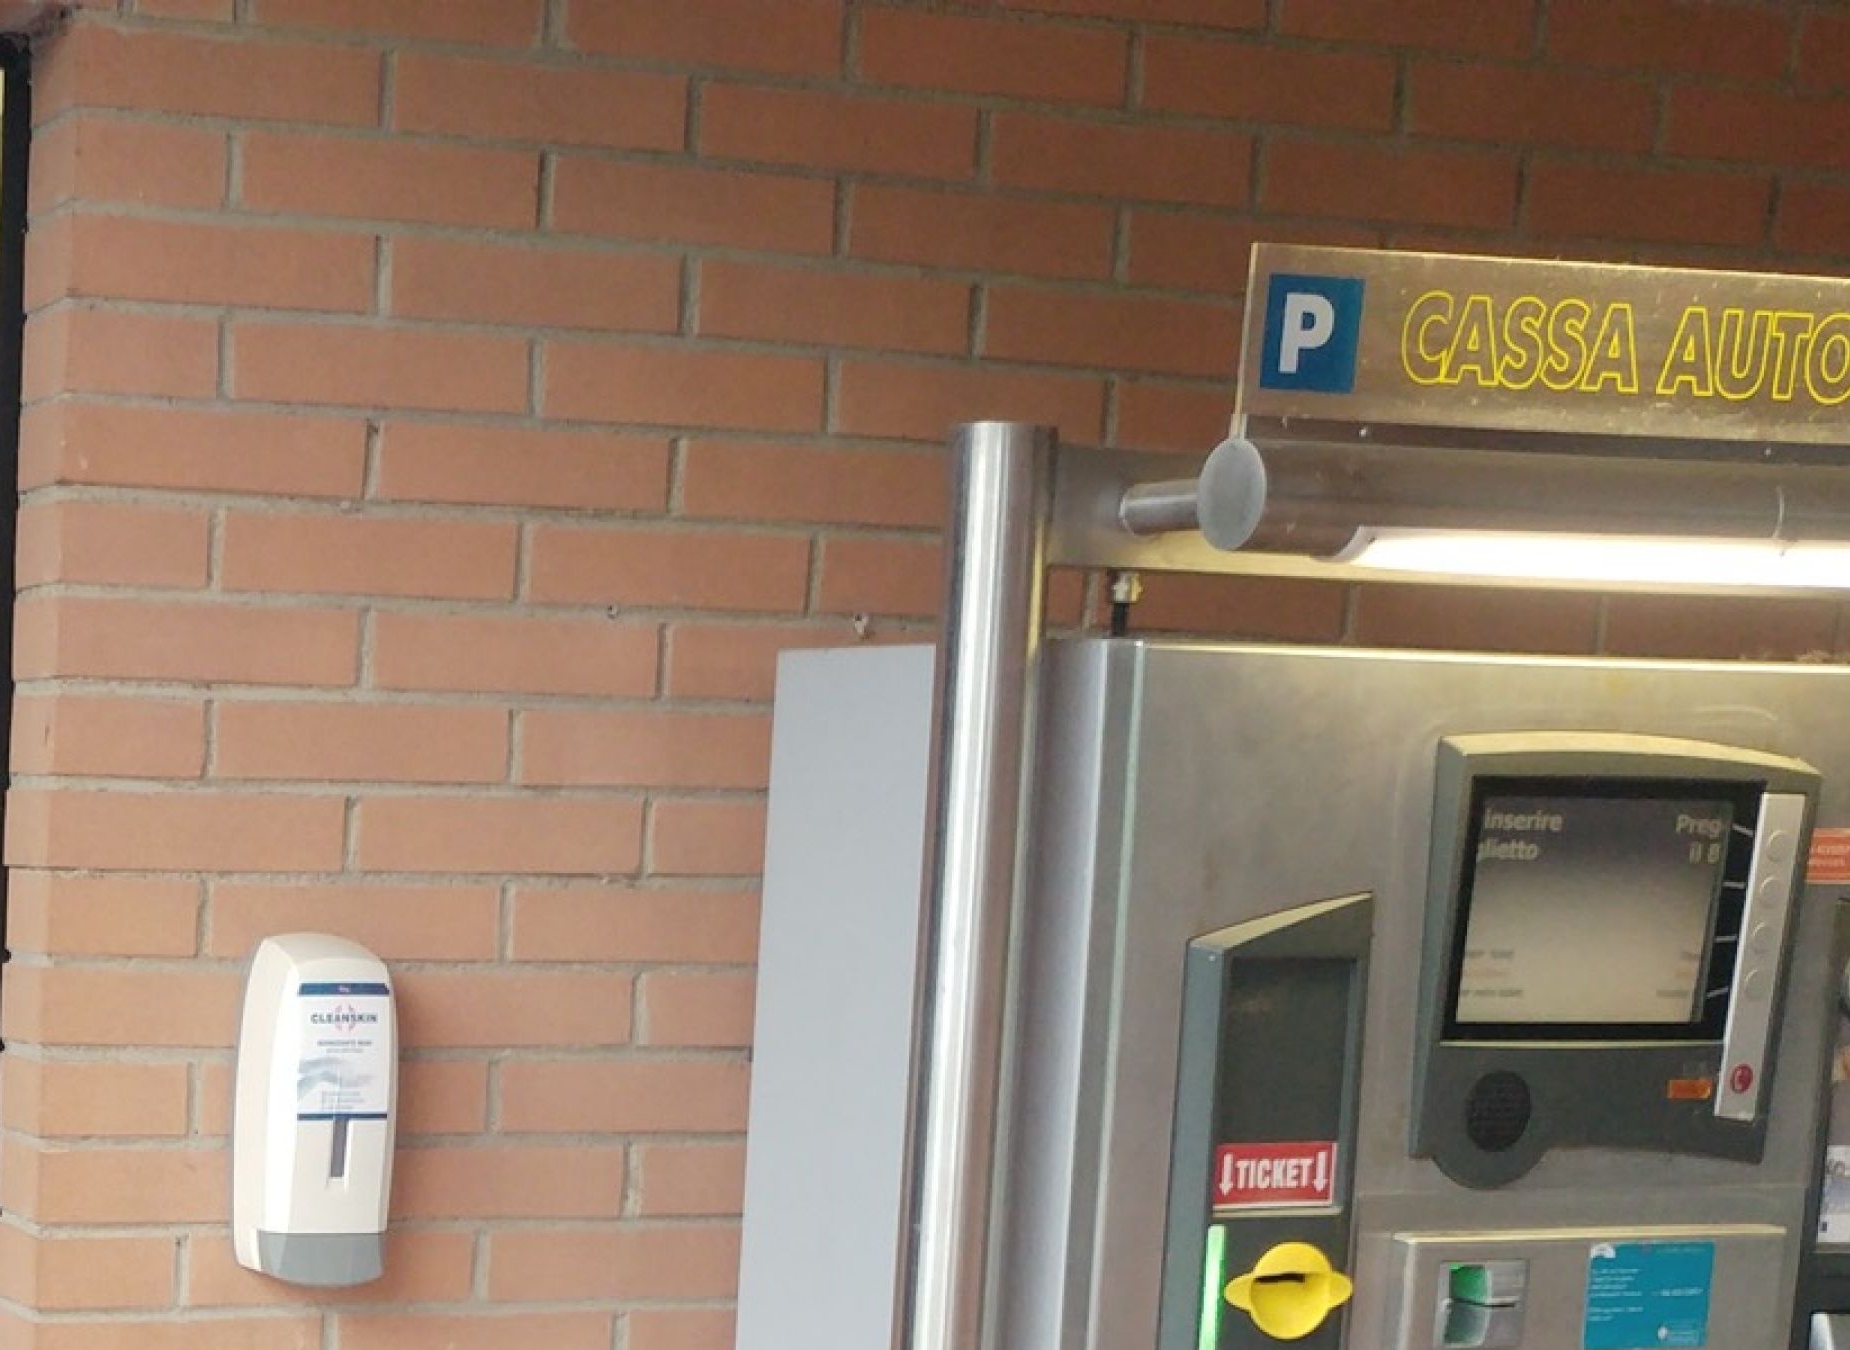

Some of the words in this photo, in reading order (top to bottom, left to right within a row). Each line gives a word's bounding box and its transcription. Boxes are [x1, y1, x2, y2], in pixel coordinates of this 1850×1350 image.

[1277, 292, 1335, 373] P
[1401, 289, 1638, 395] CASSA
[1655, 305, 1850, 405] AUTO
[1484, 808, 1563, 832] inserire
[310, 1012, 379, 1025] CLEANSKIN
[1235, 1154, 1313, 1191] TICKET
